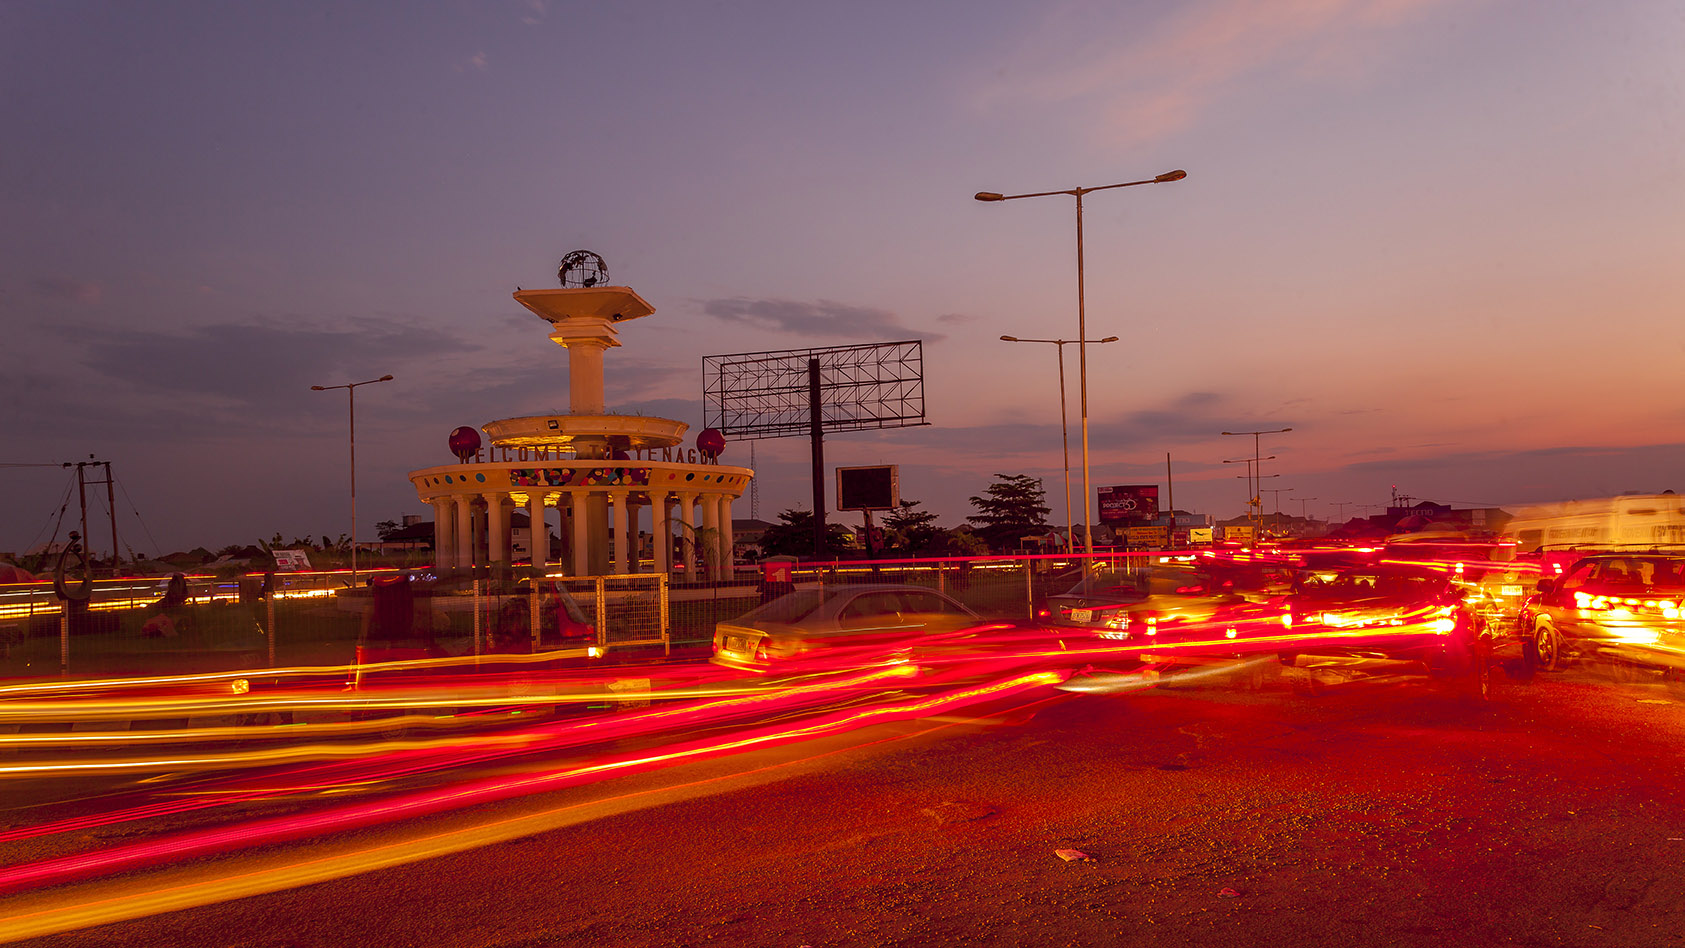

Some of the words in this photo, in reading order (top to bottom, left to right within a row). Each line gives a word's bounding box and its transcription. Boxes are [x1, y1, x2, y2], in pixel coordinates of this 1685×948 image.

[458, 445, 568, 464] WELCOME
[589, 444, 613, 461] TO
[635, 444, 719, 466] YENAGOA
